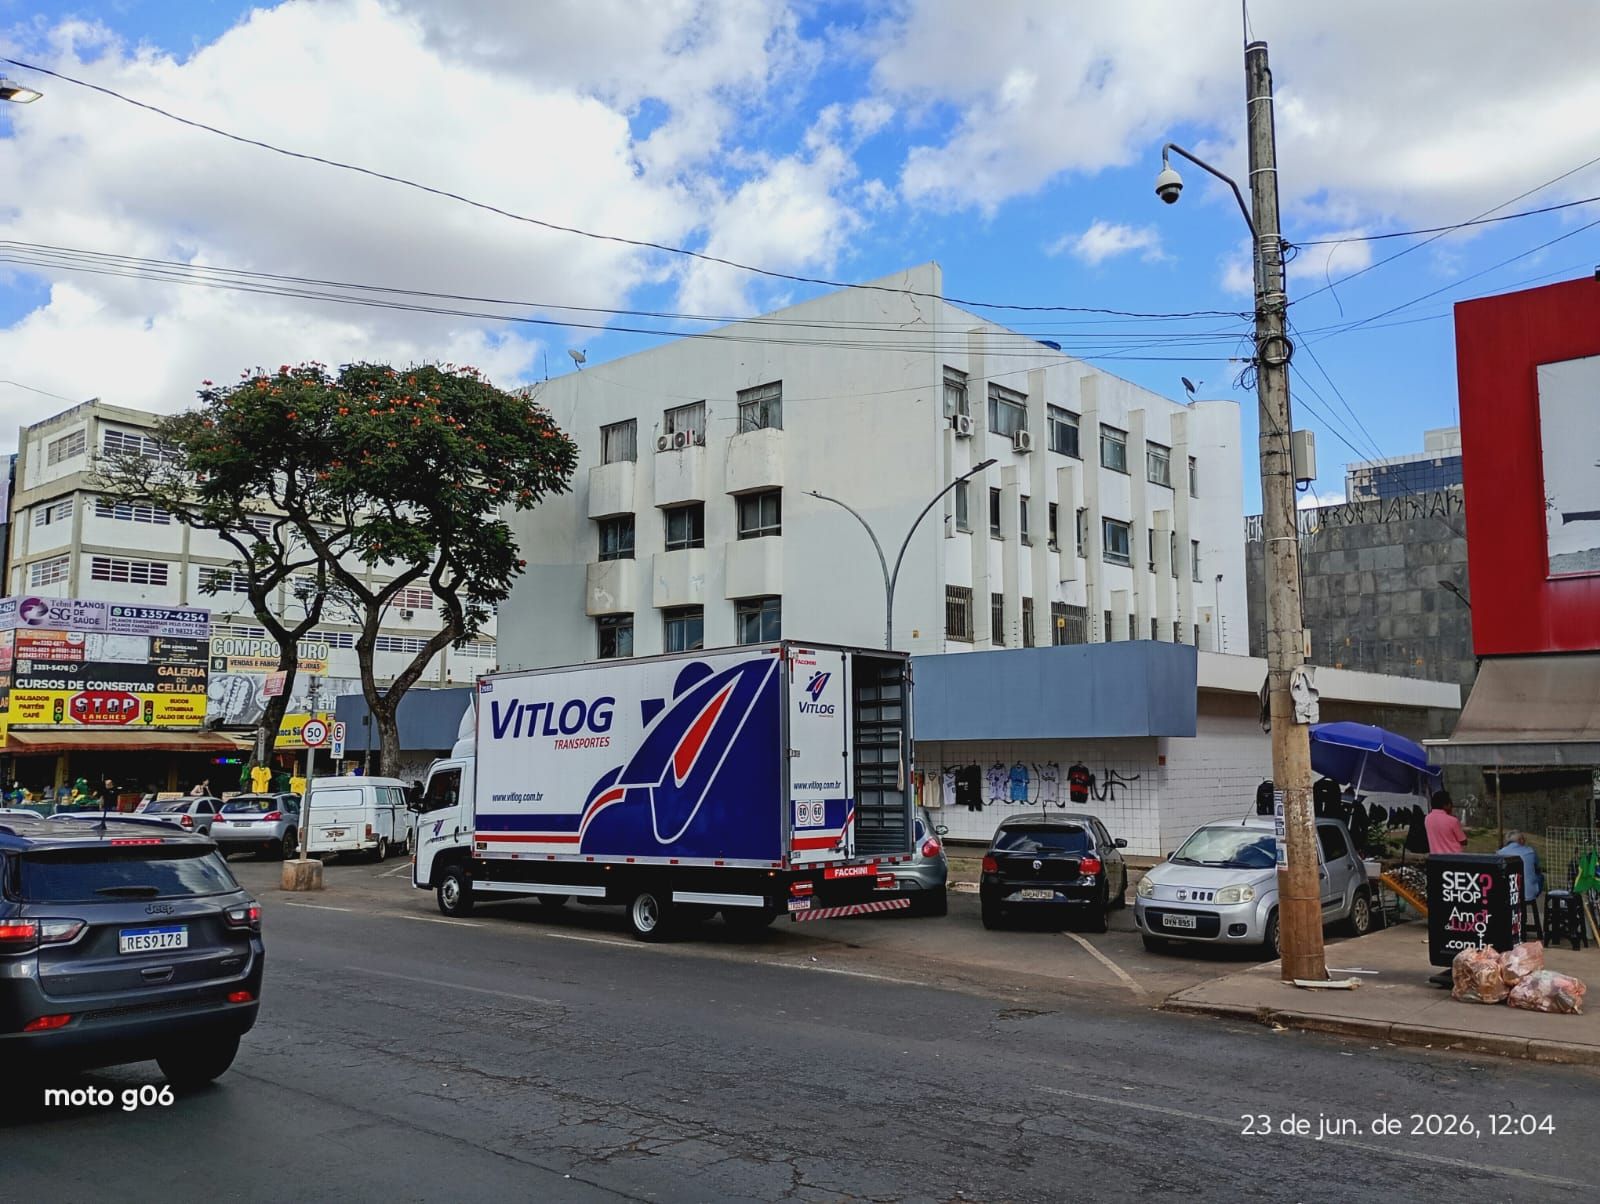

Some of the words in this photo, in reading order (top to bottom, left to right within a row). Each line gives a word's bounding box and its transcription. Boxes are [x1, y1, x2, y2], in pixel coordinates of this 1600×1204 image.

[74, 601, 105, 610] PLANOS
[49, 608, 72, 621] SG
[124, 608, 137, 617] 61
[140, 609, 205, 622] 3357-4254
[73, 616, 100, 625] SAÚDE
[212, 637, 281, 658] COMPRO
[297, 642, 328, 660] URO
[158, 667, 206, 677] GALERIA
[16, 679, 65, 689] CURSOS
[68, 680, 84, 690] DE
[86, 681, 154, 692] CONSERTAR
[157, 683, 205, 693] CELULAR
[75, 698, 134, 714] STOP
[307, 727, 322, 738] 50
[336, 727, 342, 738] E
[554, 736, 611, 750] TRANSPORTES
[793, 781, 842, 791] www.vitlog.com.br
[492, 792, 544, 804] www.vitlog.com.br
[814, 807, 822, 816] 60
[834, 866, 868, 877] FACCHINI
[1442, 889, 1481, 904] SHOP
[145, 904, 175, 914] Jeep
[1449, 906, 1492, 924] Amor
